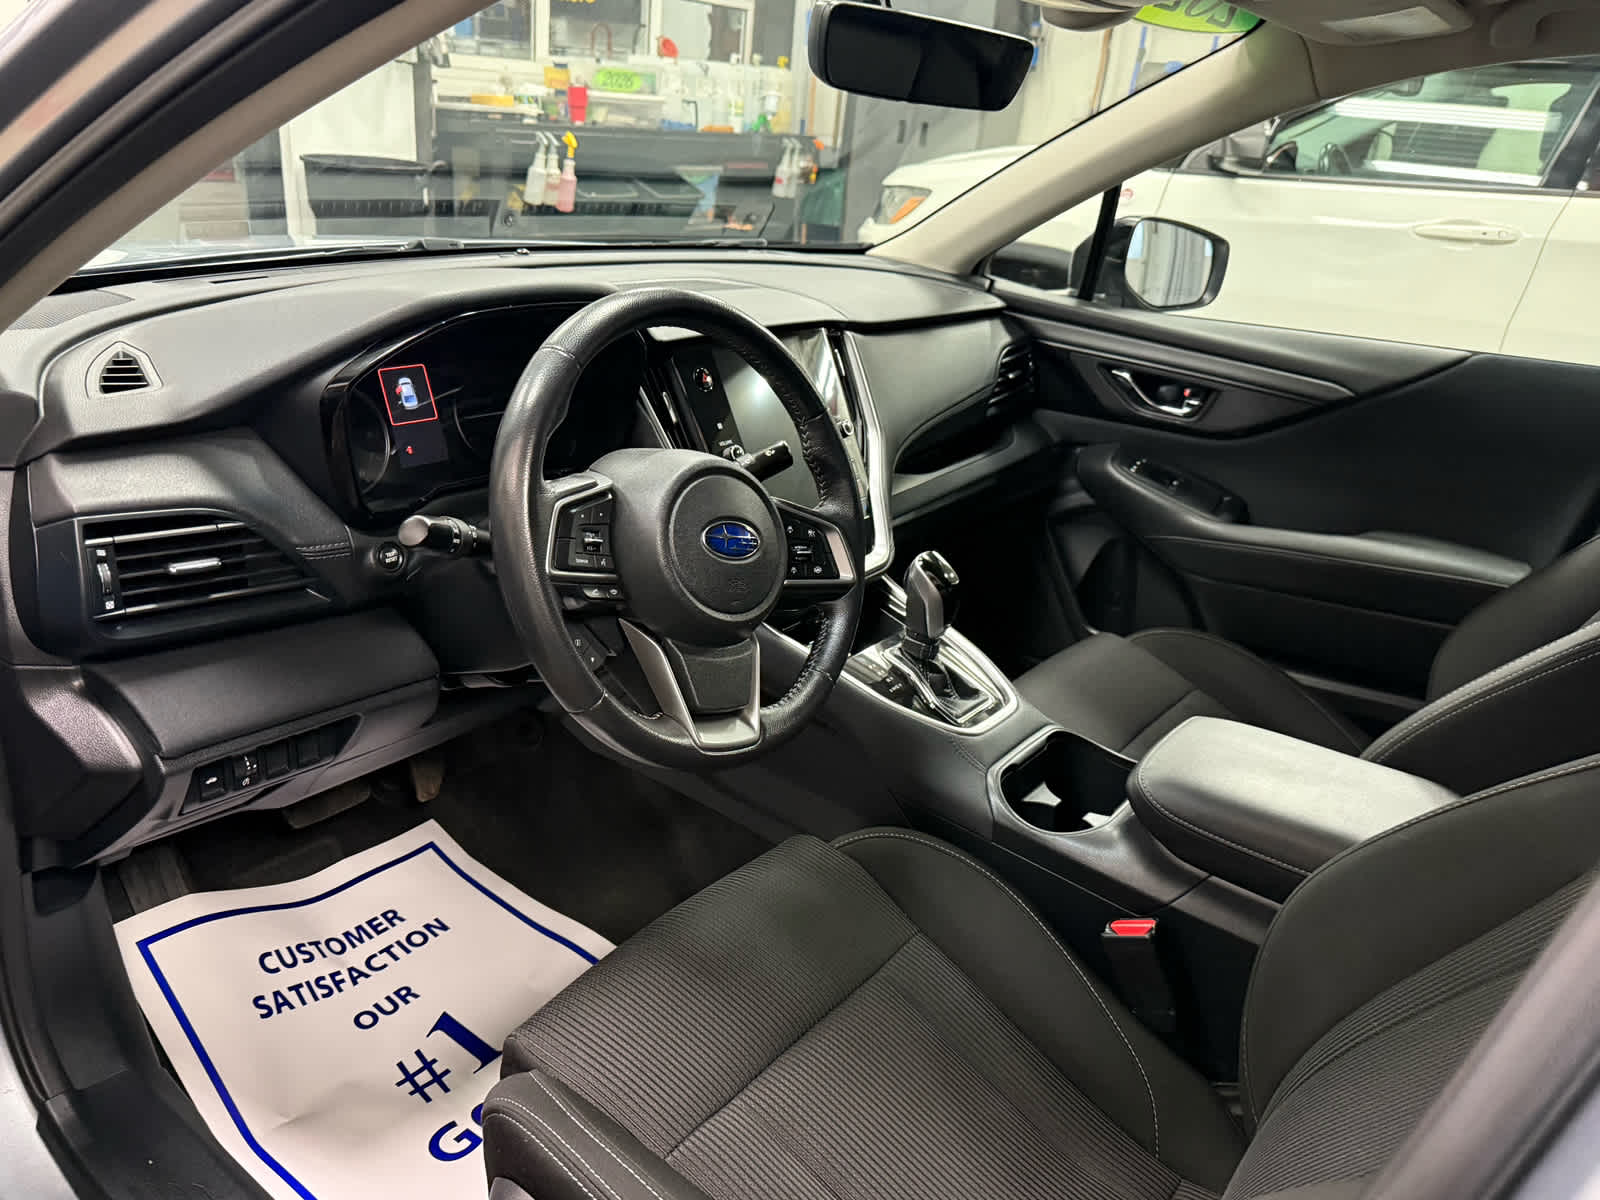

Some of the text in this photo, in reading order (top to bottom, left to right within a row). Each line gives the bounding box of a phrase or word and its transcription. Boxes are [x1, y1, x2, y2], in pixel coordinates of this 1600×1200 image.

[252, 916, 450, 1020] SATISFACTION
[258, 909, 406, 974] CUSTOMER
[353, 985, 421, 1031] OUR
[395, 1010, 504, 1104] #1
